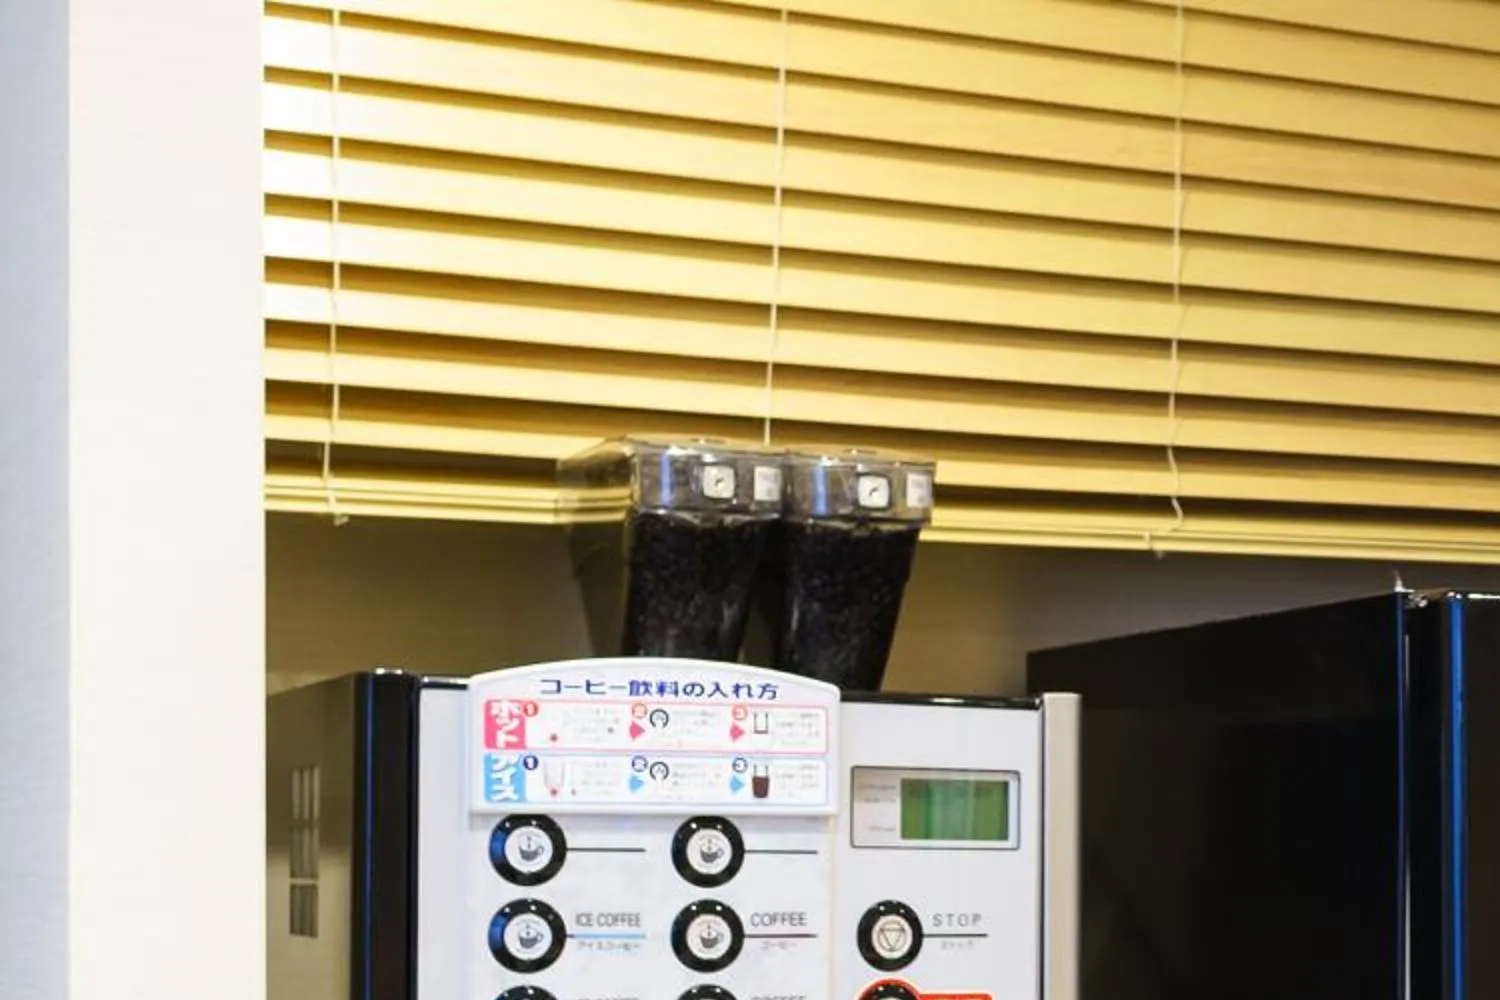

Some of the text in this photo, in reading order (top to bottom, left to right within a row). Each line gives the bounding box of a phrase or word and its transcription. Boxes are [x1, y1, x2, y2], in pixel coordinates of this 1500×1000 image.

[540, 678, 779, 700] コーヒー飲料の入れ方
[491, 702, 520, 748] ホット
[491, 754, 520, 801] アイス
[575, 912, 641, 928] ICE COFFEE
[749, 911, 807, 927] COFFEE
[932, 912, 982, 928] STOP
